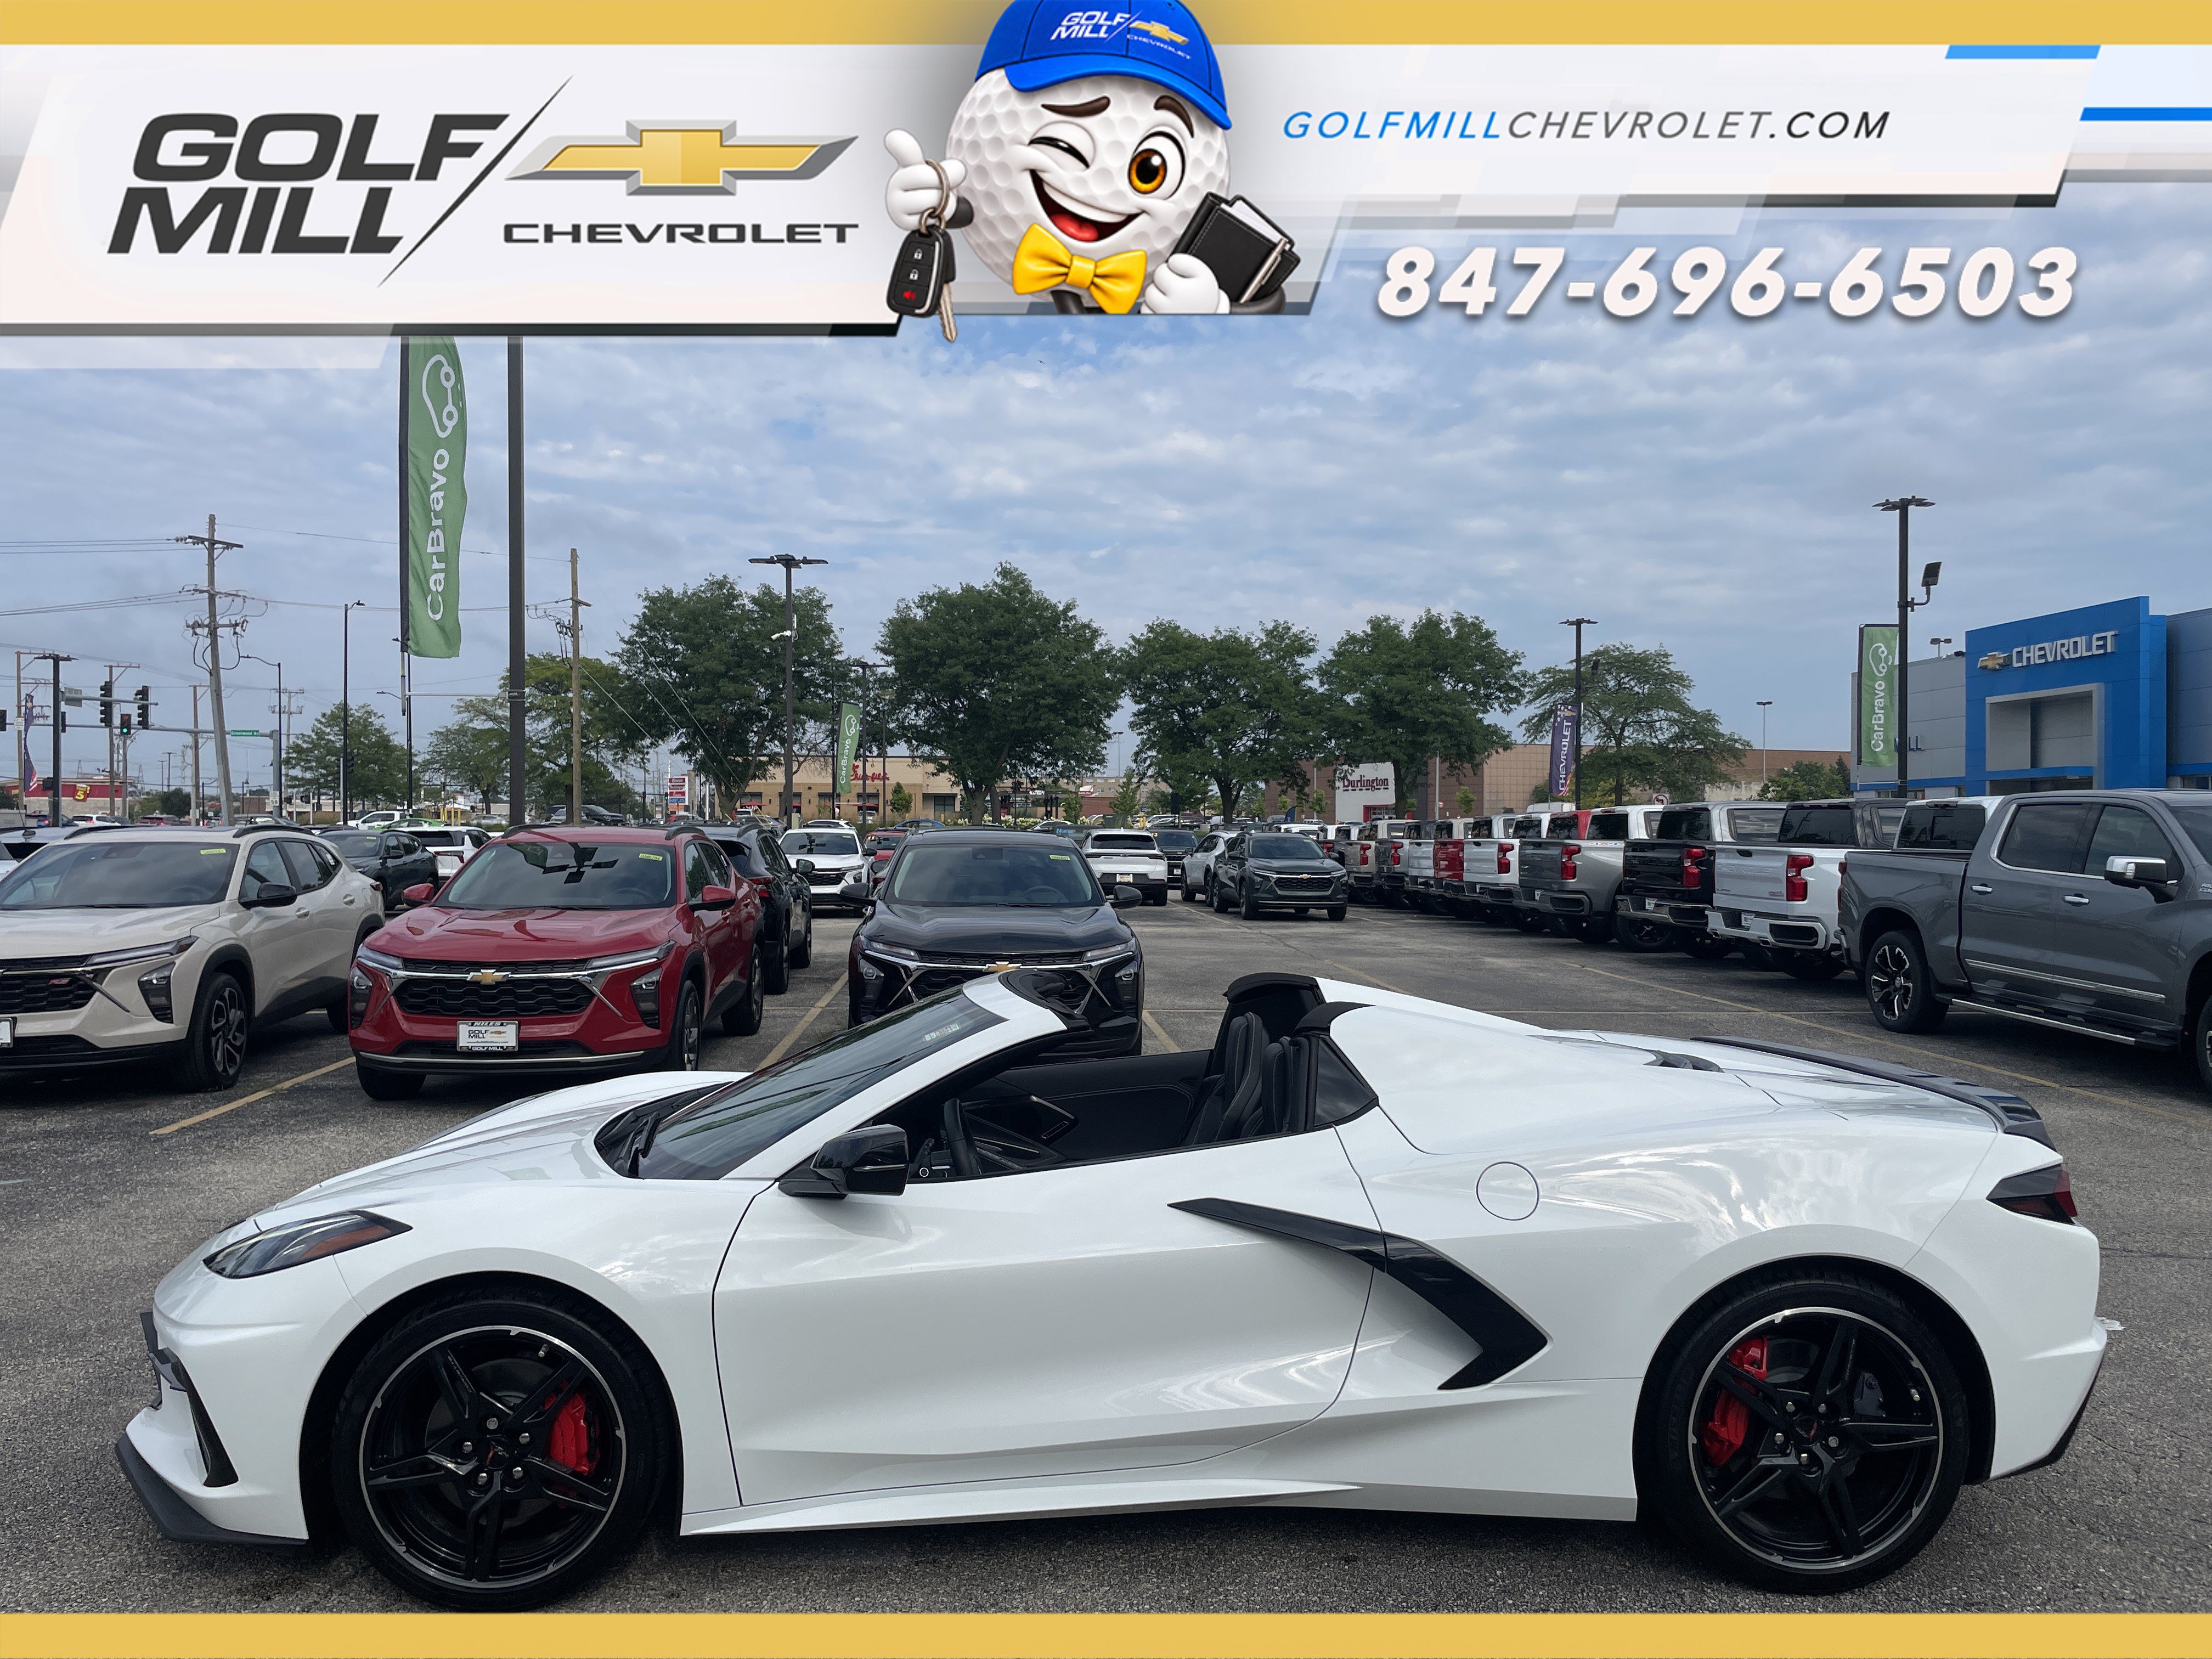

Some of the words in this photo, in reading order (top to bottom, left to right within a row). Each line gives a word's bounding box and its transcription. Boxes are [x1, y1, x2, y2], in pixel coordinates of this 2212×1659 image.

[426, 448, 450, 621] CarBravo
[2012, 630, 2119, 668] CHEVROLET
[1870, 680, 1886, 752] CarBravo
[840, 738, 851, 785] CarBravo
[1342, 774, 1389, 792] Burlington
[1559, 719, 1572, 791] CHEVROLET
